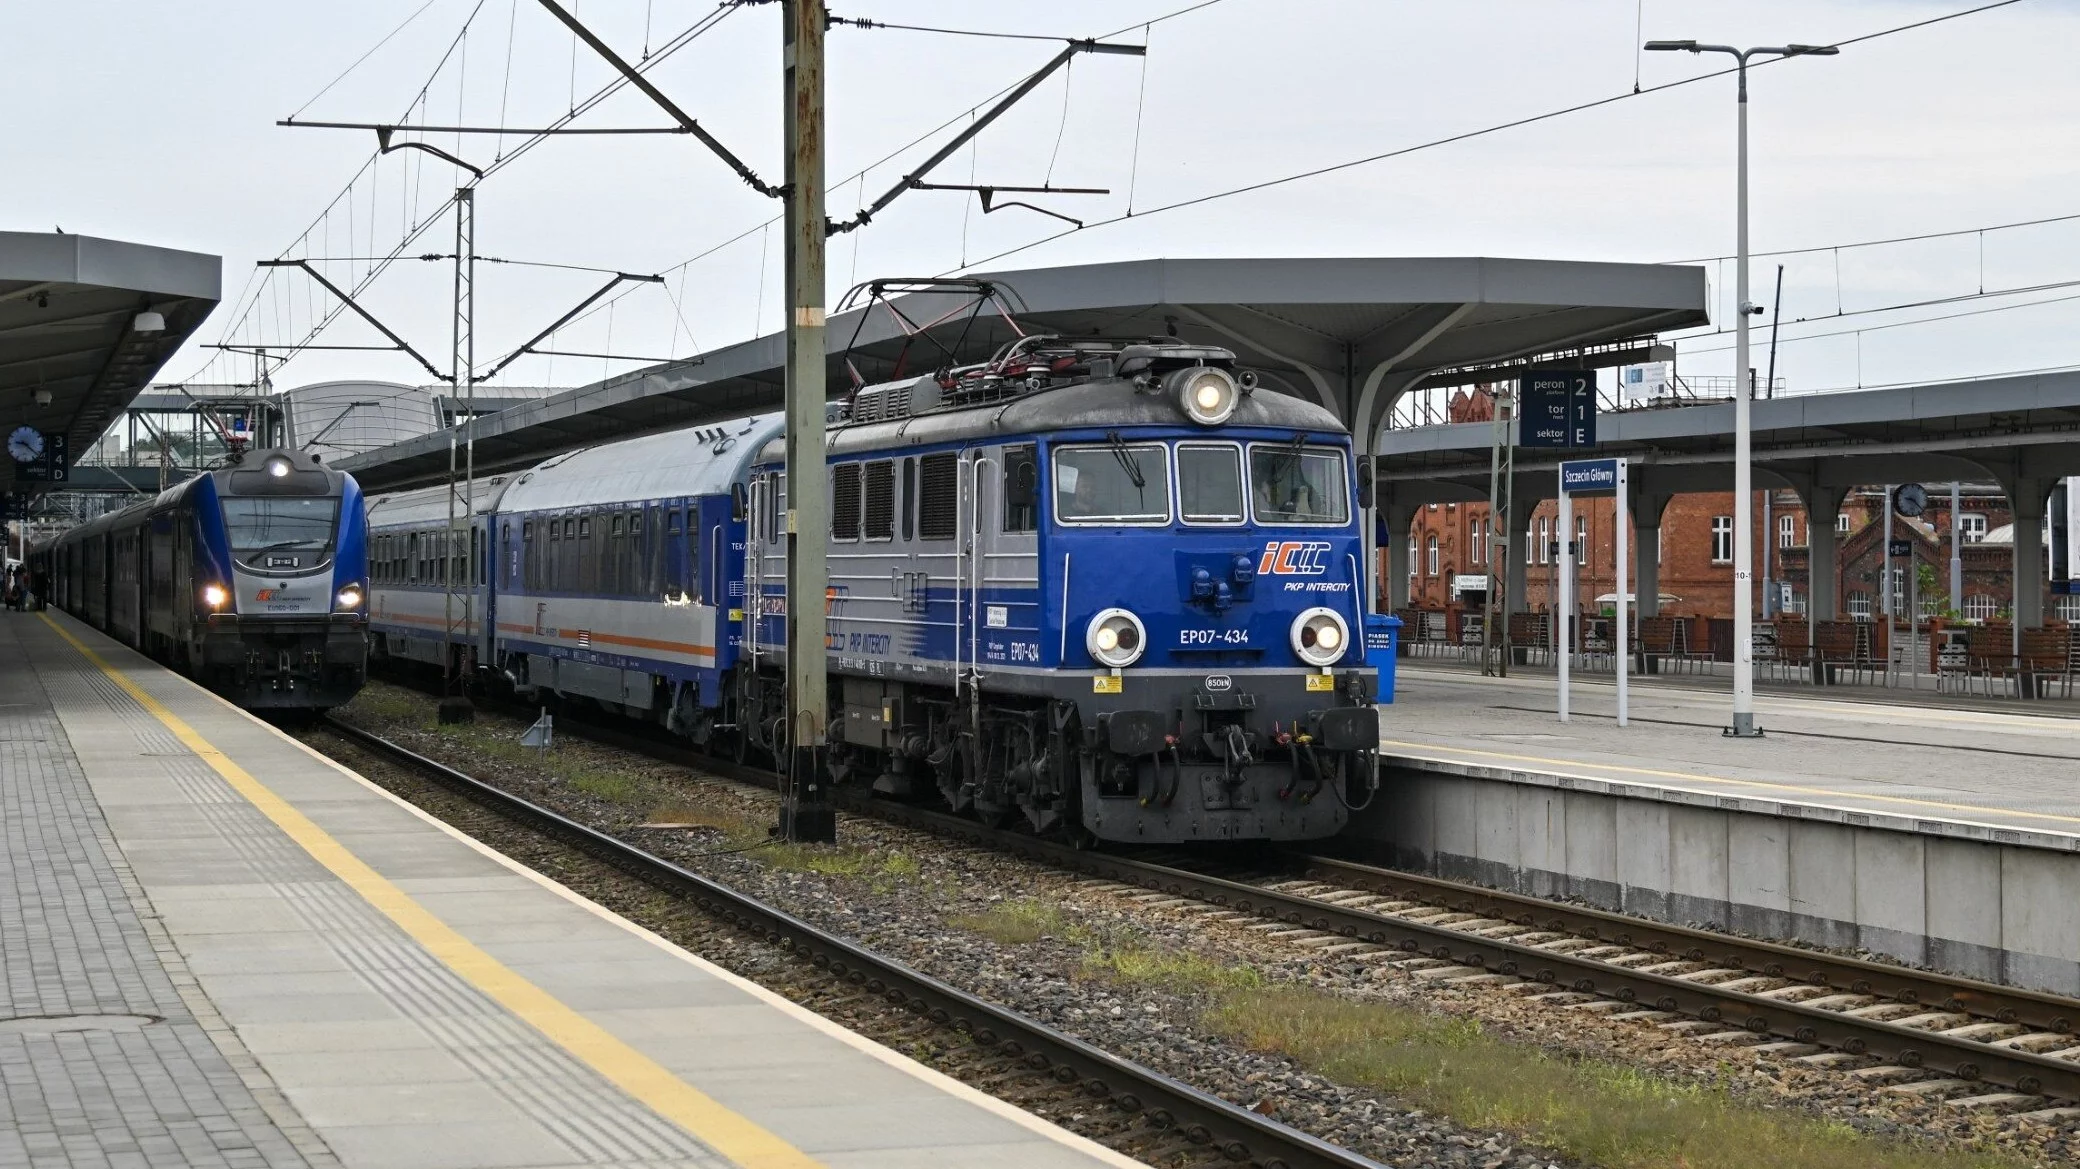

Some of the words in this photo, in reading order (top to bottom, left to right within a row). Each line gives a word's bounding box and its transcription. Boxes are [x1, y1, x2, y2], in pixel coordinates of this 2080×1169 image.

[1534, 381, 1565, 391] peron
[1575, 378, 1587, 396] 2
[1548, 405, 1565, 414] tor
[1578, 405, 1584, 420] 1
[55, 436, 63, 448] 3
[1536, 428, 1564, 438] sektor
[1576, 428, 1585, 443] E
[55, 454, 63, 465] 4
[54, 469, 63, 480] D
[1565, 469, 1590, 483] Szczecin
[1590, 468, 1614, 484] Główny
[1284, 582, 1305, 591] PKP
[1306, 582, 1351, 591] INTERCITY
[849, 632, 862, 653] PKP
[862, 633, 892, 656] INTERCITY
[1180, 629, 1249, 644] EP07-434
[1011, 641, 1039, 662] EP07-434
[1207, 678, 1230, 687] 850kN
